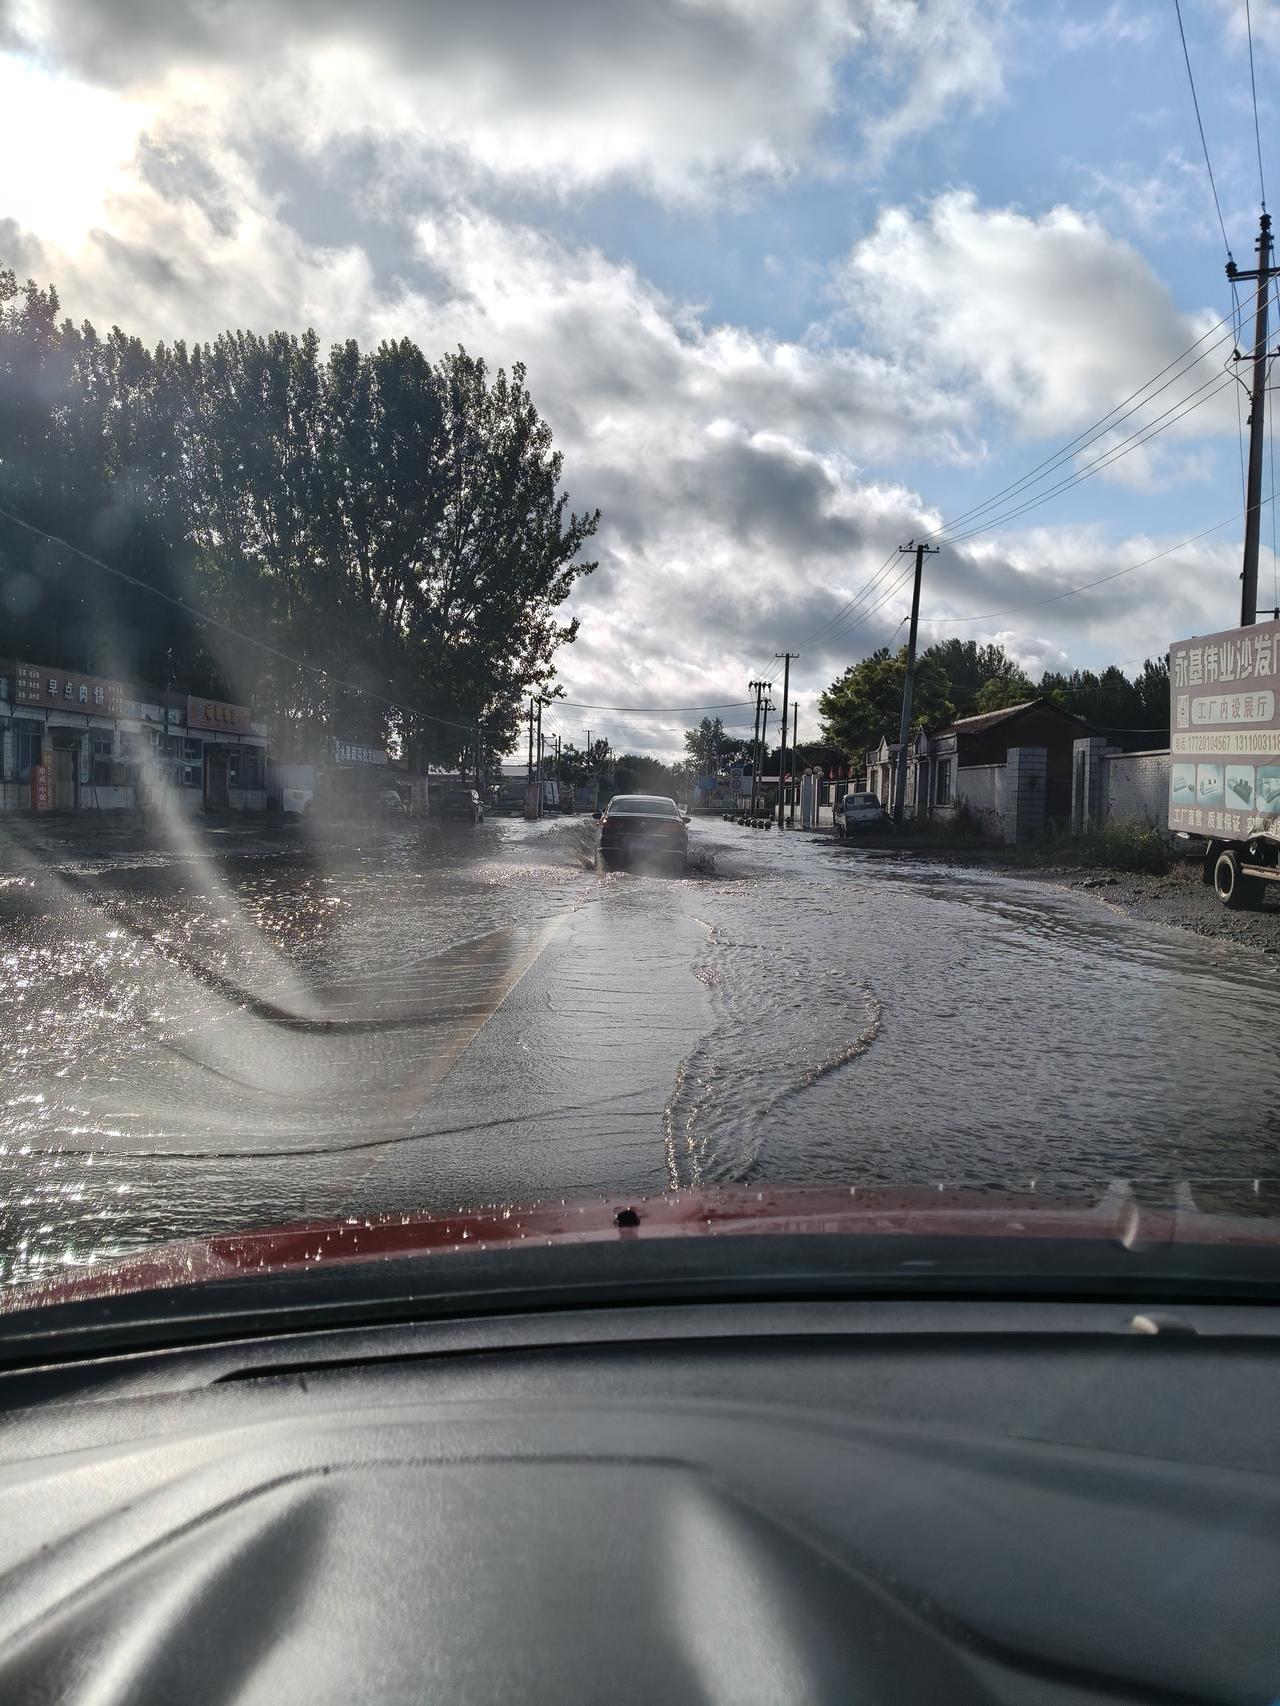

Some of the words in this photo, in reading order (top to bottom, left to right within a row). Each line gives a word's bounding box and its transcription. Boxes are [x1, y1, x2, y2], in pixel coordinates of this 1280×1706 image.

[48, 679, 105, 705] 早点肉饼
[1197, 695, 1268, 721] 工厂内设展厅
[1173, 808, 1202, 827] 工厂直营
[1207, 811, 1241, 833] 质量保证
